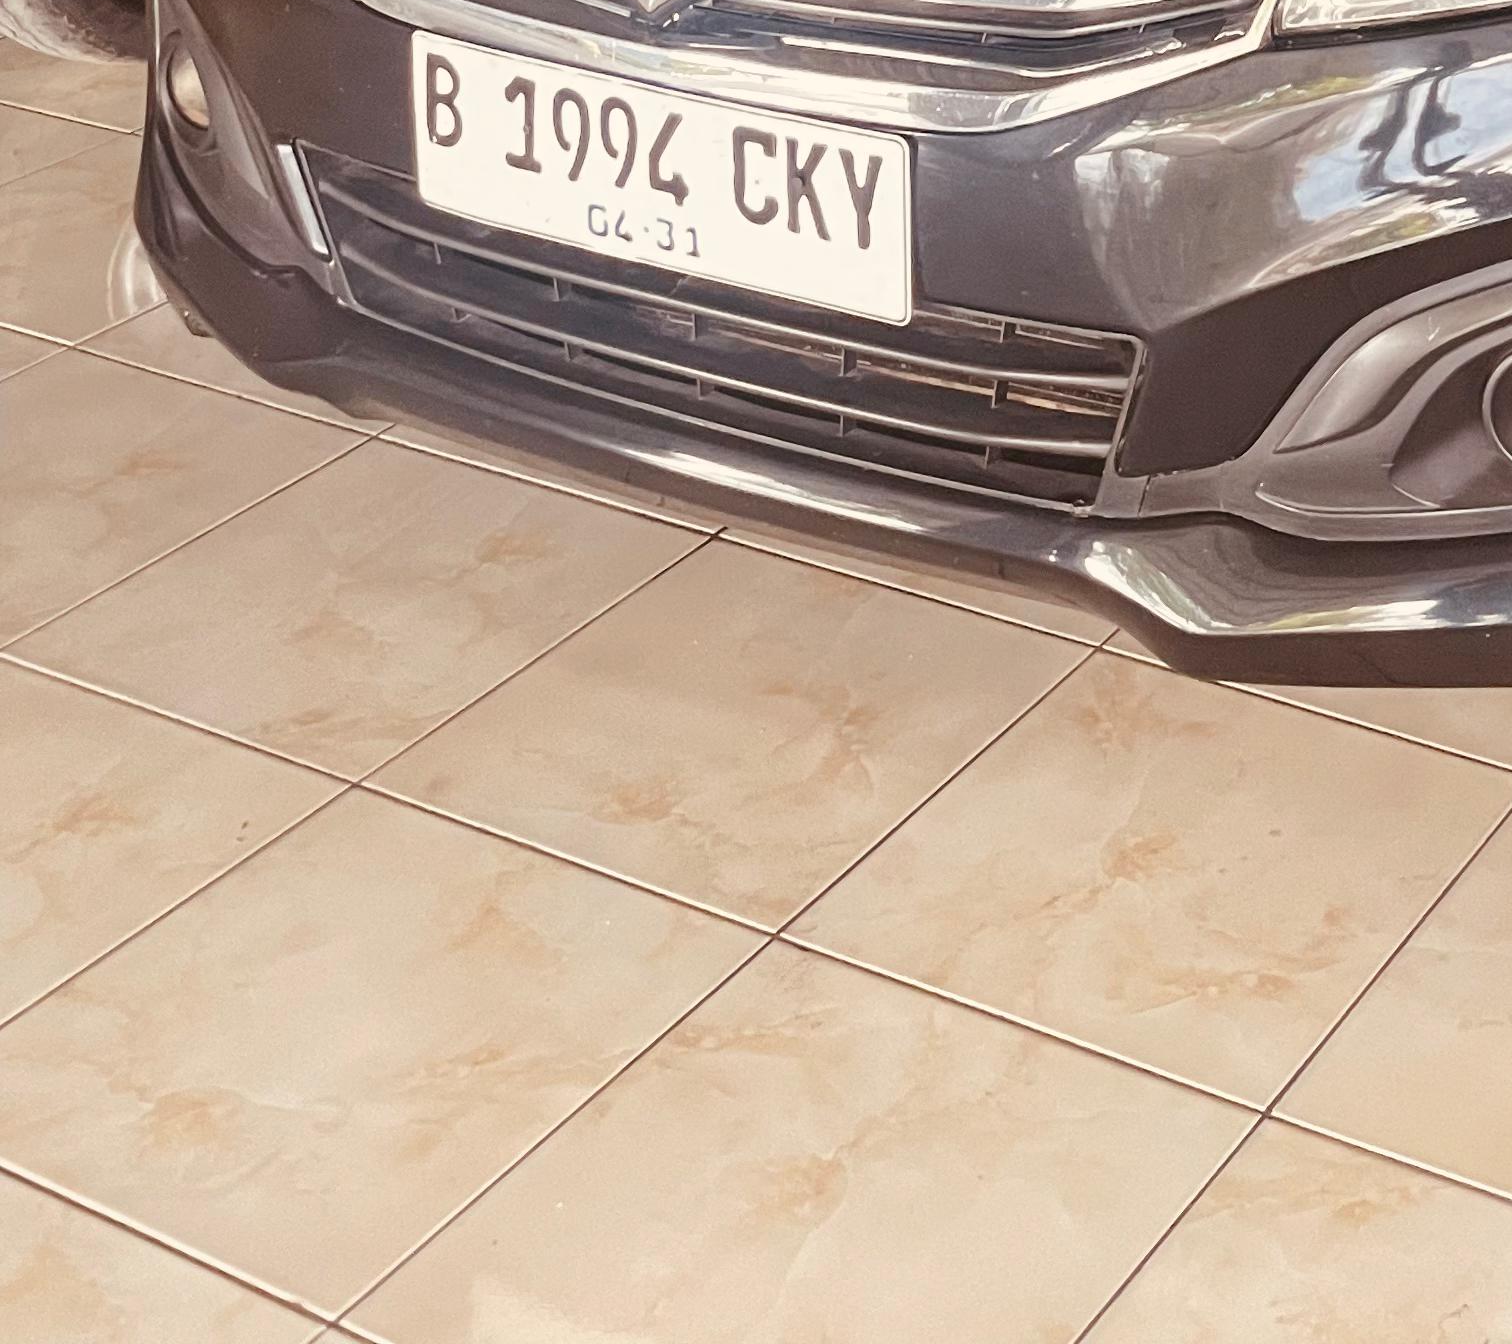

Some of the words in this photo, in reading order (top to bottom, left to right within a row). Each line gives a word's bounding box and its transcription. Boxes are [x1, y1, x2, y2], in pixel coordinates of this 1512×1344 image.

[425, 53, 463, 147] B
[505, 75, 690, 207] 1994
[732, 125, 883, 250] CKY
